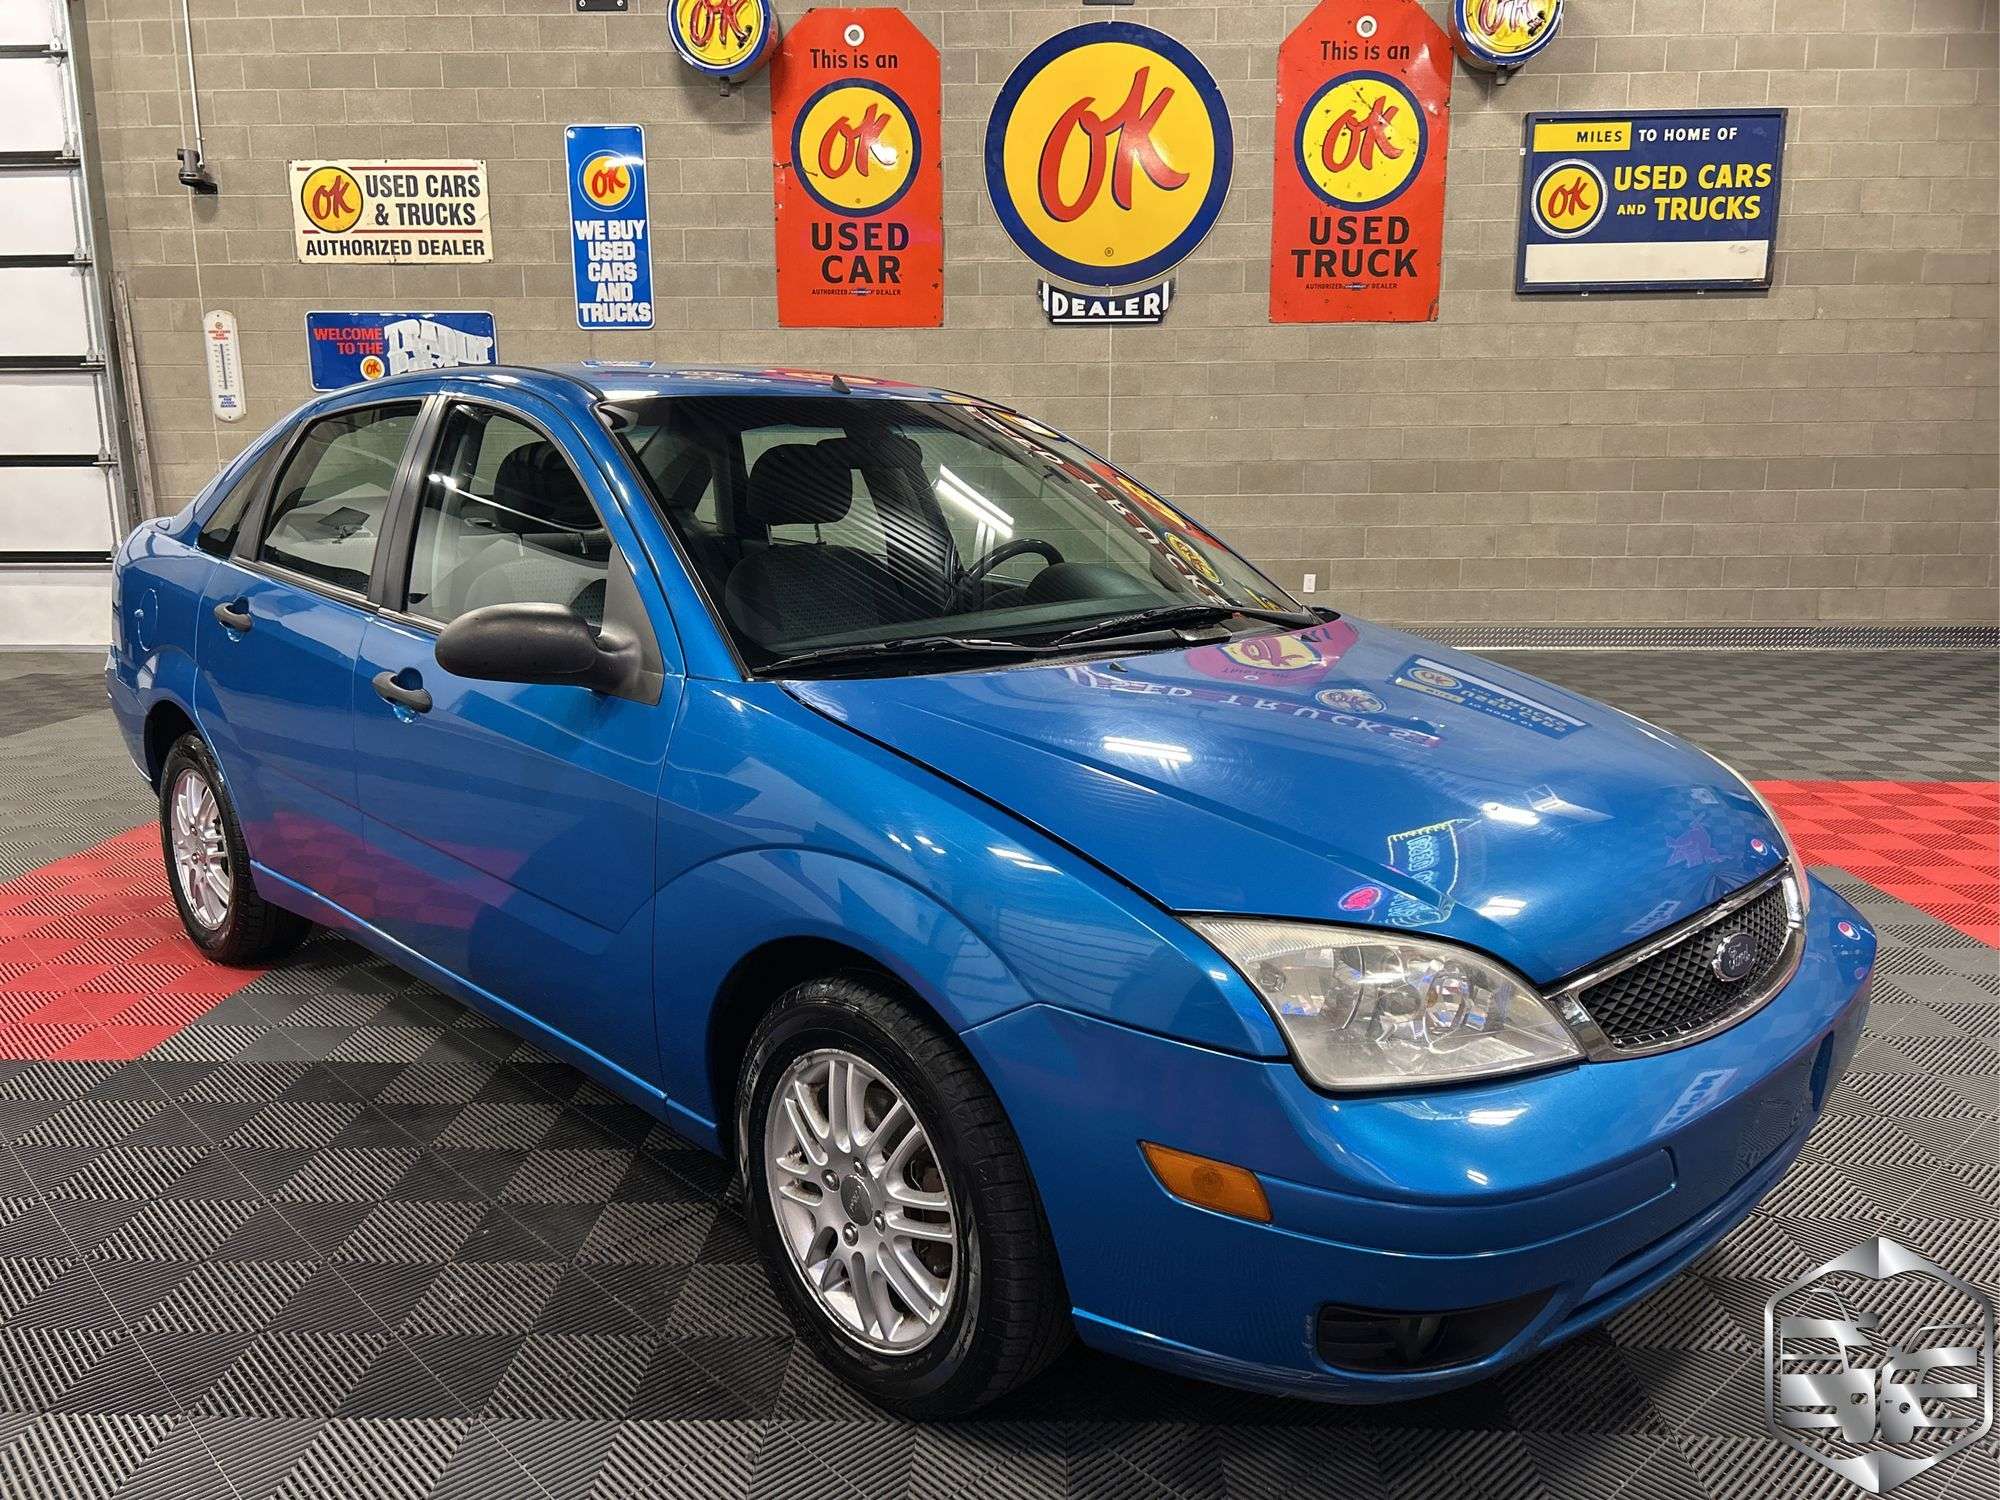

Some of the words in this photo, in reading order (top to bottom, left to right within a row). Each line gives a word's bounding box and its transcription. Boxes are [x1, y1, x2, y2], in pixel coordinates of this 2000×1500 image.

[810, 48, 848, 69] This
[853, 49, 870, 69] is
[875, 53, 898, 69] an
[1320, 40, 1358, 60] This
[1364, 41, 1380, 60] is
[1387, 44, 1410, 60] an
[818, 103, 899, 179] OK
[1037, 65, 1190, 223] OK
[1321, 95, 1404, 173] OK
[1576, 130, 1623, 143] MILES
[1639, 128, 1657, 142] TO
[1663, 127, 1710, 142] HOME
[1717, 126, 1738, 140] OF
[365, 174, 419, 198] USED
[425, 174, 481, 198] CARS
[592, 166, 626, 198] OK
[1613, 165, 1689, 191] USED
[1698, 163, 1773, 190] CARS
[312, 174, 355, 220] OK
[1547, 176, 1591, 219] OK
[1616, 204, 1646, 216] AND
[1654, 195, 1761, 221] TRUCKS
[375, 203, 389, 226] &
[396, 203, 476, 226] TRUCKS
[574, 220, 605, 240] WE
[607, 220, 646, 240] BUY
[811, 222, 910, 251] USED
[1309, 216, 1410, 245] USED
[306, 239, 412, 256] AUTHORIZED
[418, 239, 485, 256] DEALER
[587, 241, 636, 261] USED
[587, 262, 638, 282] CARS
[821, 255, 901, 284] CAR
[1291, 249, 1418, 278] TRUCK
[596, 283, 633, 302] AND
[1052, 291, 1162, 317] DEALER
[579, 302, 652, 323] TRUCKS
[313, 327, 383, 341] WELCOME
[337, 342, 357, 355] TO
[359, 342, 384, 355] THE
[366, 362, 381, 374] OK
